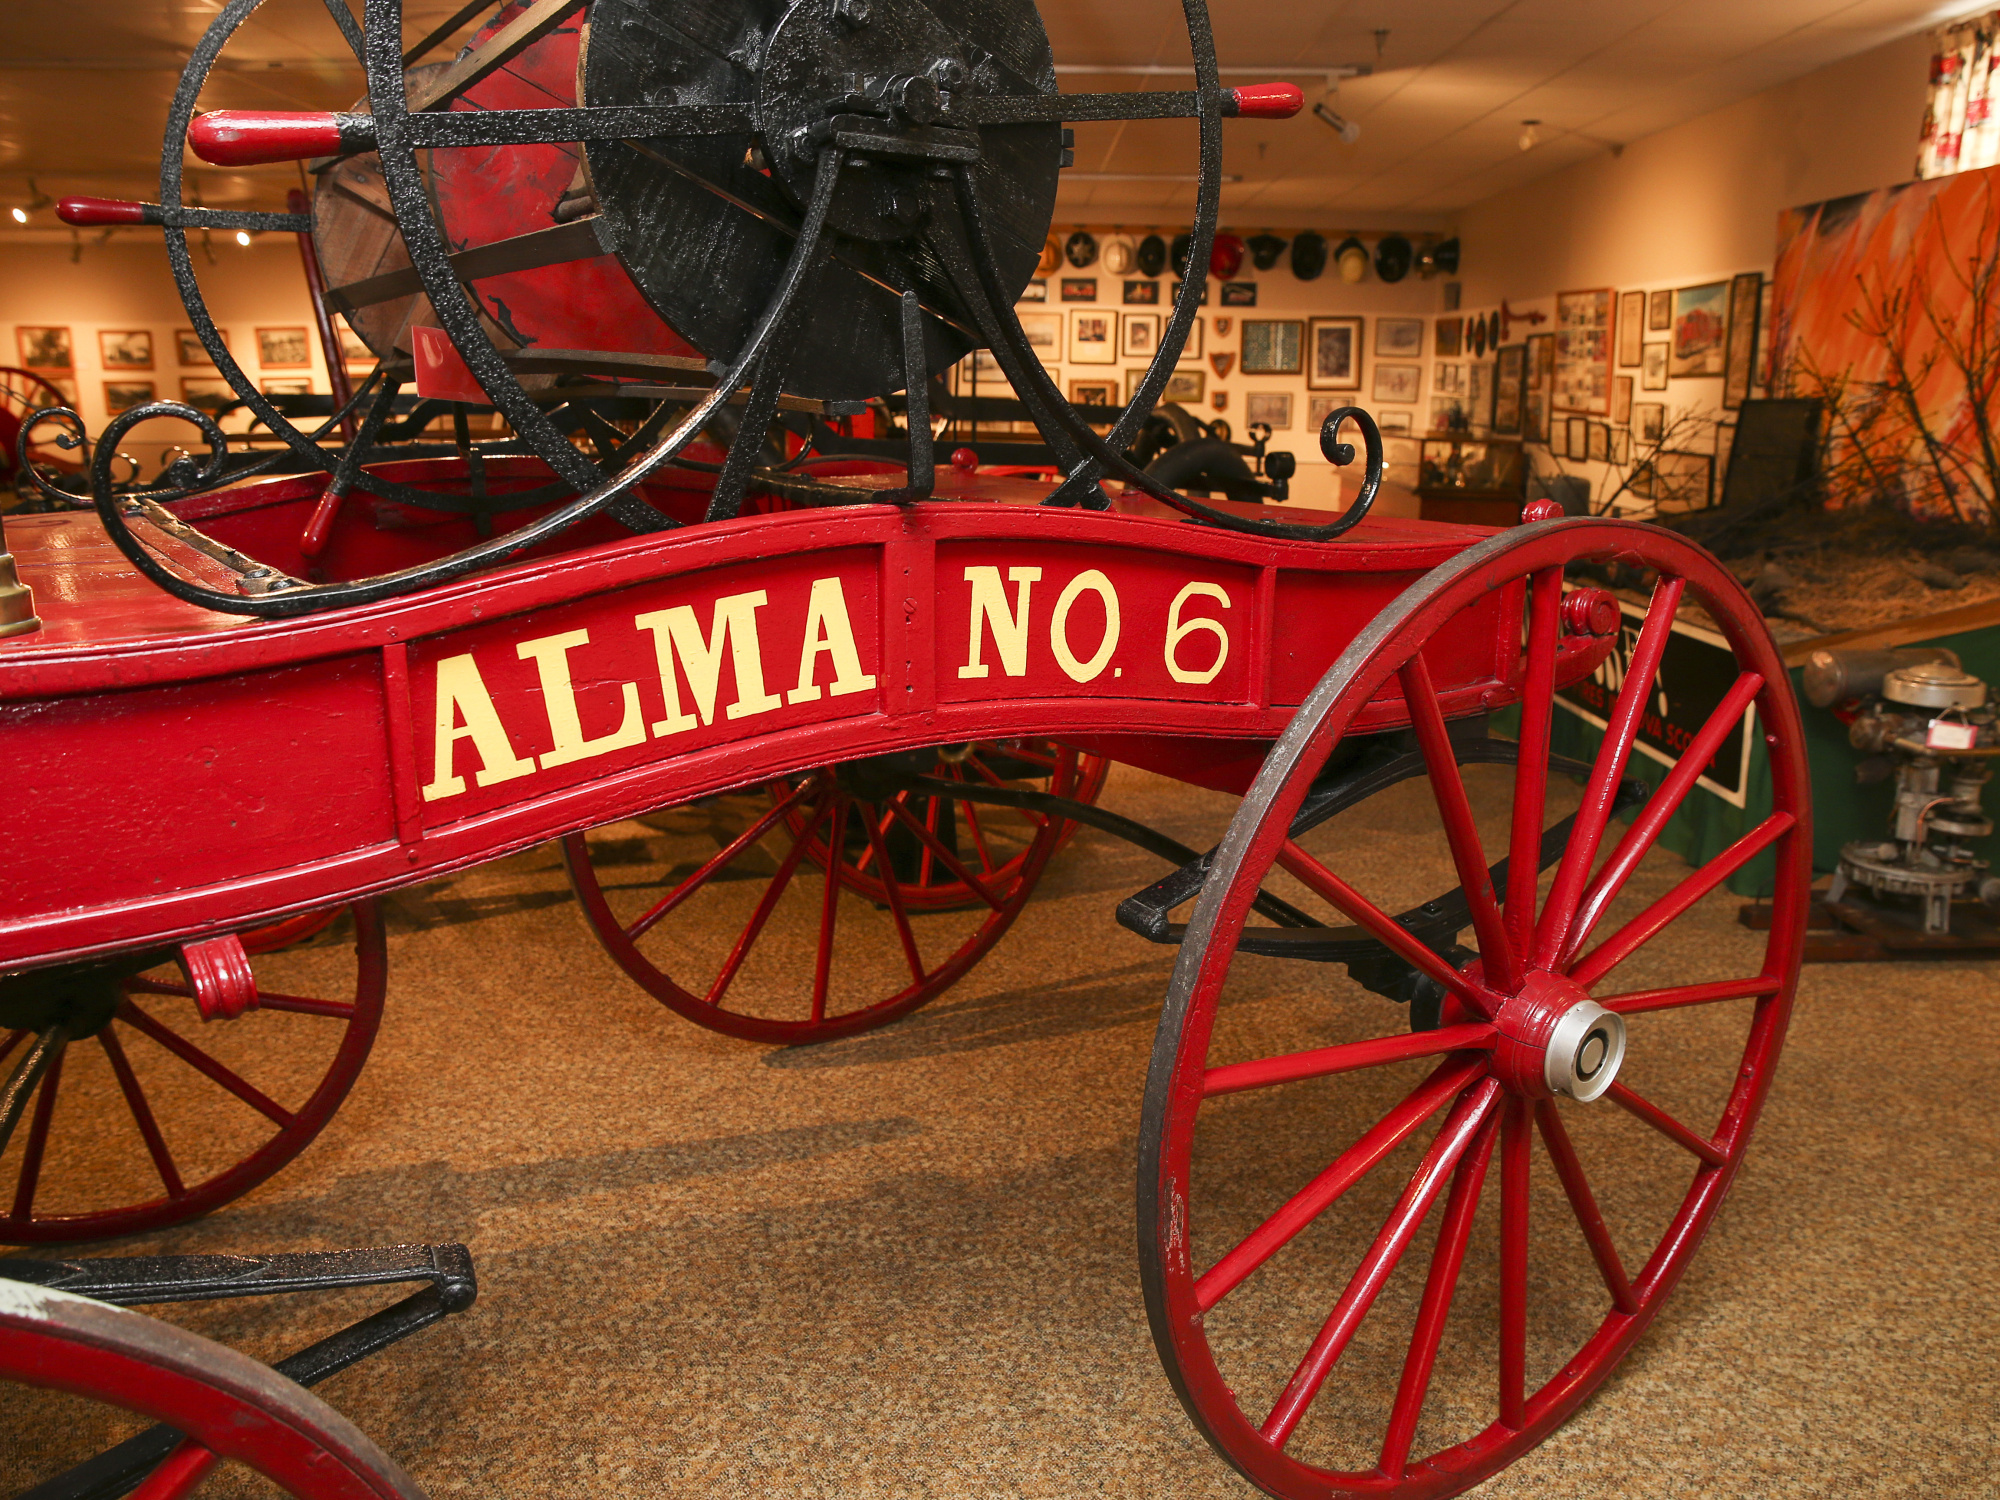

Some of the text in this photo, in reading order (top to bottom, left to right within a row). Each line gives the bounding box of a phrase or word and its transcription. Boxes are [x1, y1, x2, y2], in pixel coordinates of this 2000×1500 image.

[422, 565, 1231, 802] ALMA NO. 6
